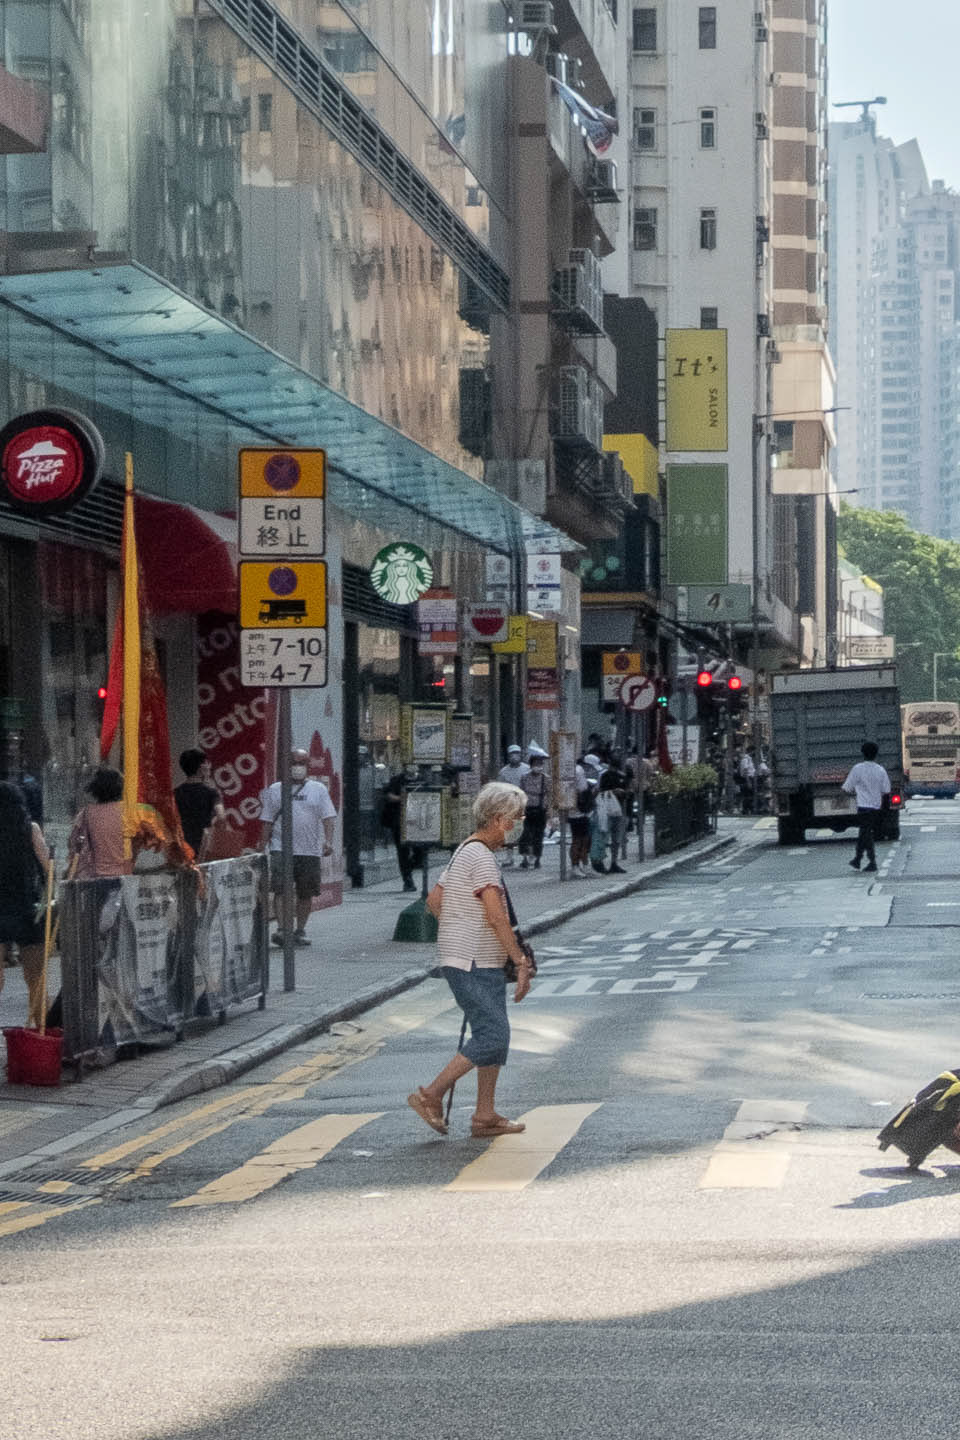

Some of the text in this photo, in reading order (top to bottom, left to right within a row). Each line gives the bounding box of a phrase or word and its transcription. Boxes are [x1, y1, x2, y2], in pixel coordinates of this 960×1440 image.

[709, 387, 719, 427] SALON
[17, 457, 64, 478] Pizza
[25, 469, 61, 489] Hut
[264, 505, 301, 520] End
[256, 526, 309, 547] 終止
[270, 638, 322, 656] 7-10
[248, 660, 265, 669] pm
[270, 664, 312, 682] 4-7
